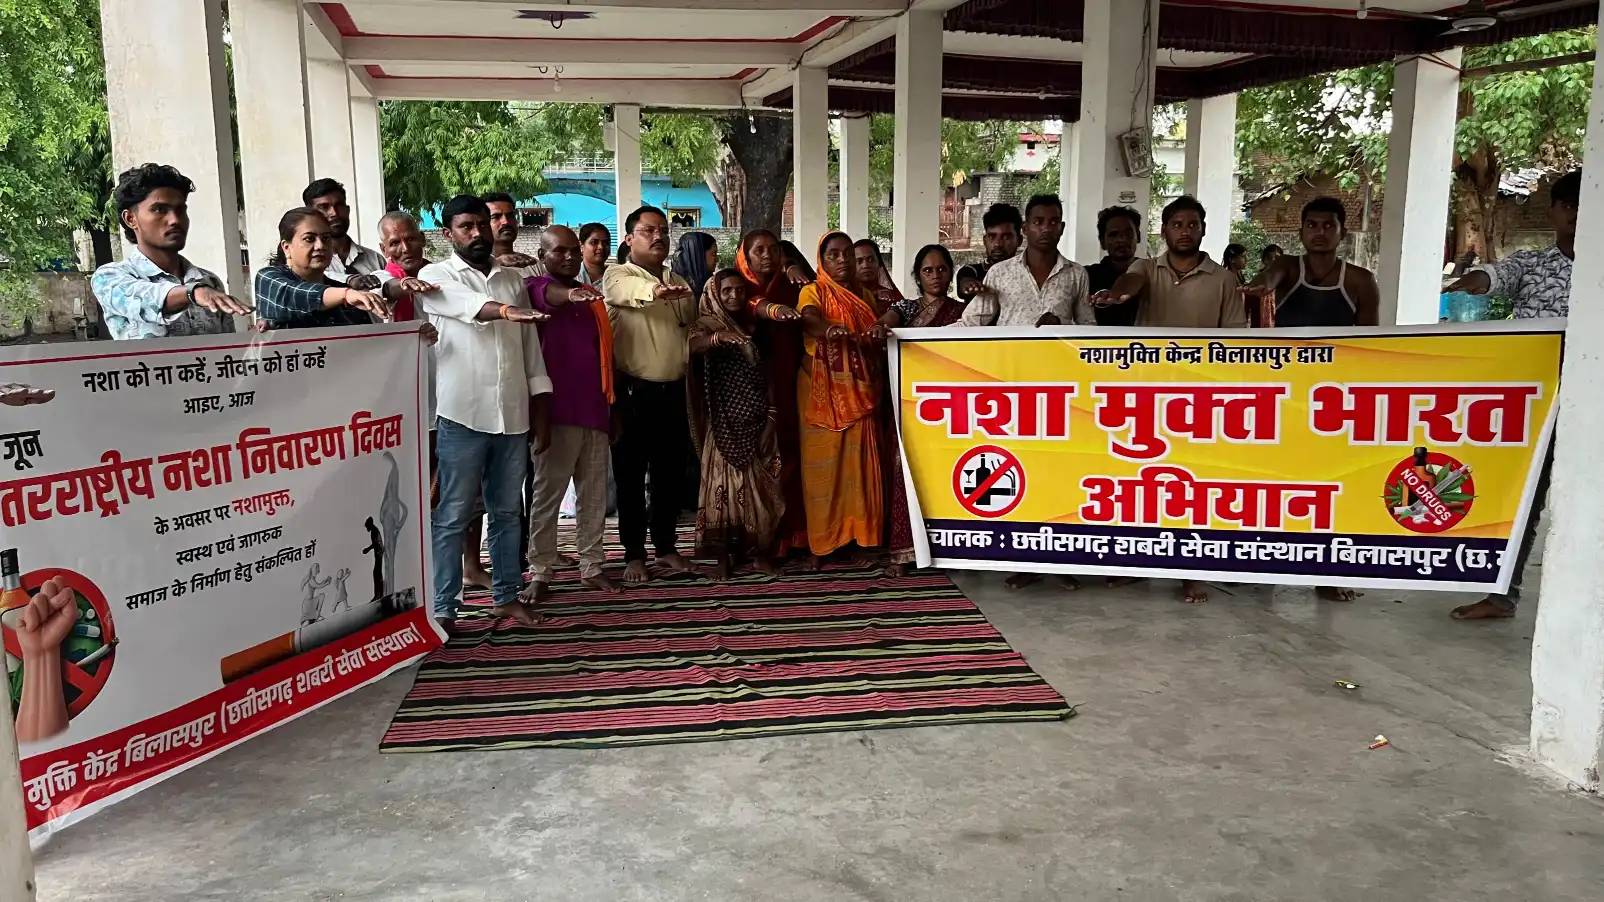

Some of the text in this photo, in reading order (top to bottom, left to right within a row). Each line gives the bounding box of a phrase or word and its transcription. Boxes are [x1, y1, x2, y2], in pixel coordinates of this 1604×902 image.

[82, 346, 327, 392] नशा को ना कहें, जीवन को हां कहें
[1079, 341, 1334, 370] नशामुक्ति केन्द्र बिलासपुर द्वारा
[183, 390, 256, 414] आइए, आज
[913, 382, 1542, 462] नशा मुक्त भारत
[0, 430, 44, 470] जून
[0, 410, 404, 528] तरराष्ट्रीय नशा निवारण दिवस
[154, 488, 295, 536] के अवसर पर नशामुक्त,
[1079, 464, 1343, 532] अभियान
[1400, 468, 1452, 522] NO DRUGS
[176, 543, 213, 566] स्वस्थ
[216, 534, 235, 555] एवं
[926, 524, 994, 548] चालक
[1011, 526, 1111, 560] छत्तीसगढ़
[1114, 532, 1178, 558] शबरी
[1179, 534, 1229, 560] सेवा
[1234, 536, 1326, 564] संस्थान
[1330, 538, 1452, 574] बिलासपुर
[126, 539, 316, 610] समाज के निर्माण हेतु संकल्पित हों
[24, 622, 426, 811] मुक्ति केंद्र बिलासपुर (छत्तीसगढ़ शबरी सेवा संस्थान)
